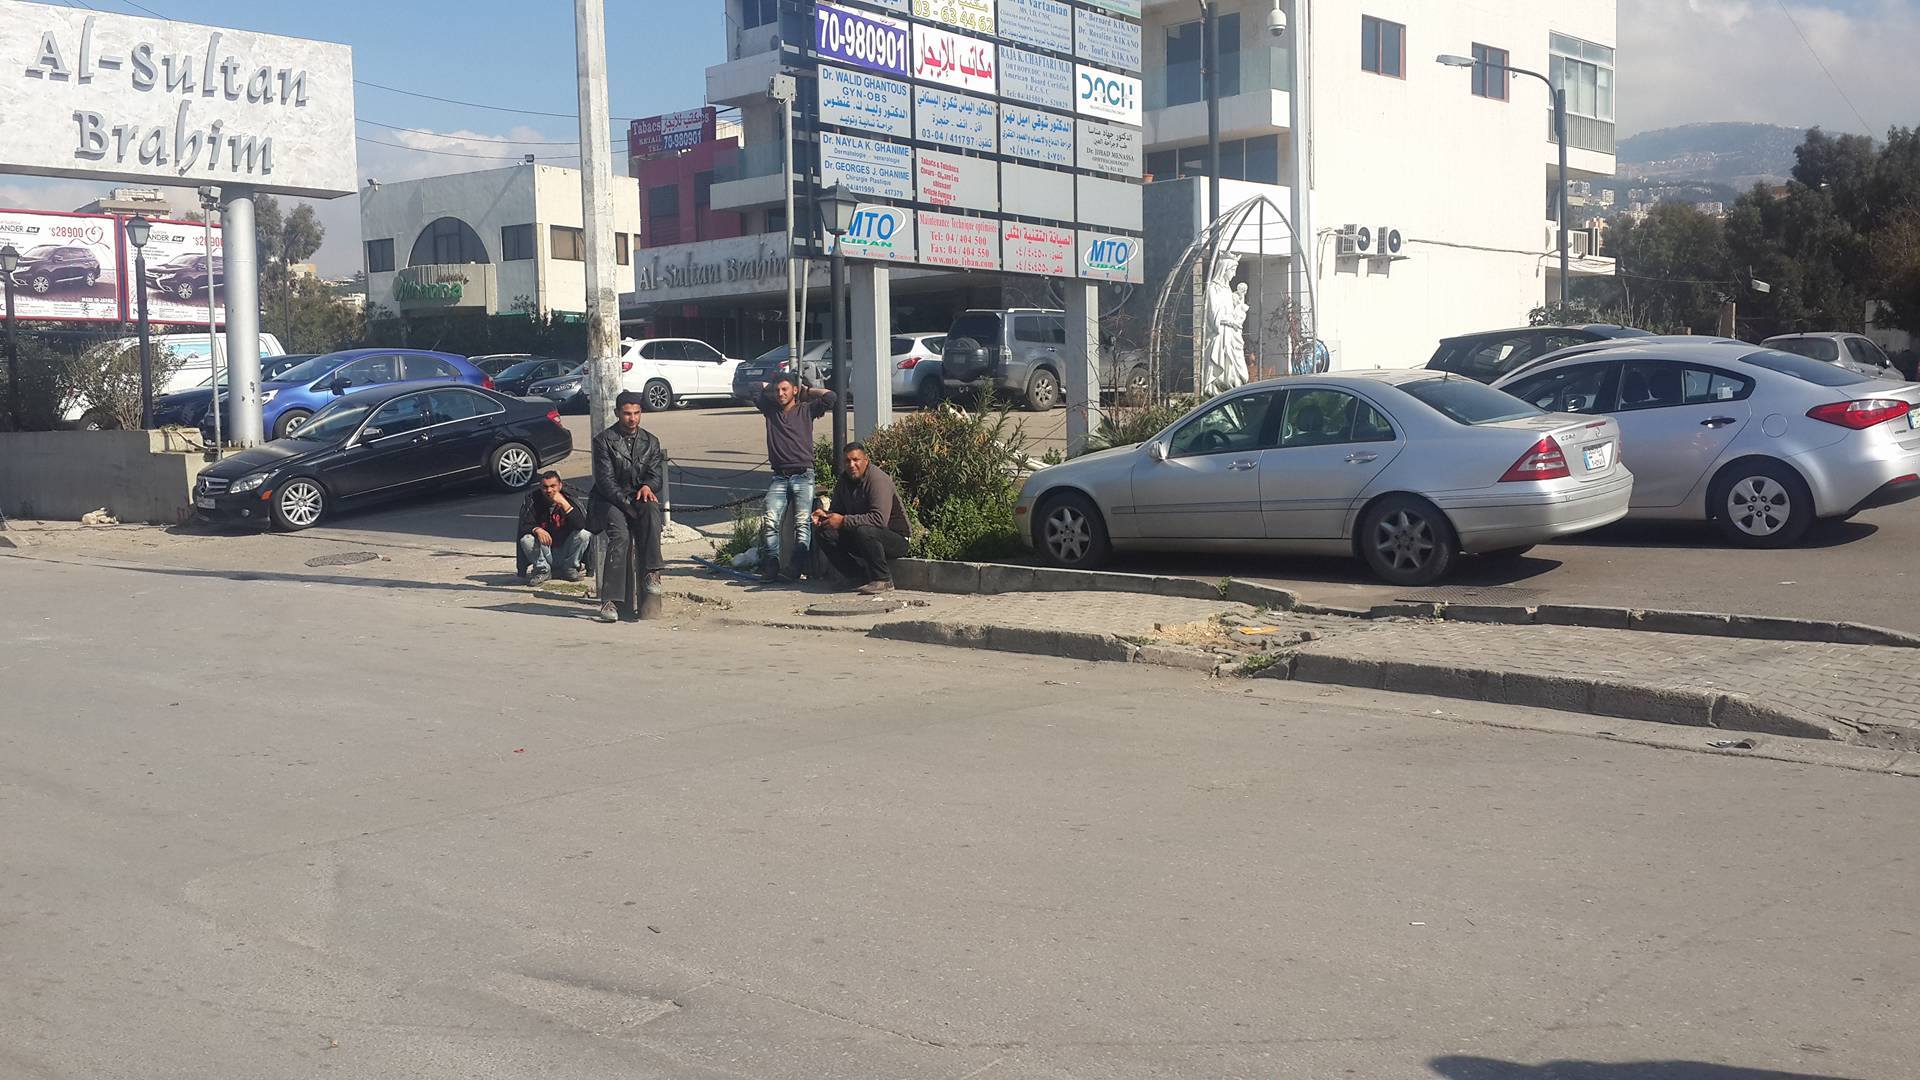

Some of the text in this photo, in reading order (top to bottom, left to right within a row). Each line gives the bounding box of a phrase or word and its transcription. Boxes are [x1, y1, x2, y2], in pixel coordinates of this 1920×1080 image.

[914, 0, 930, 17] 03
[941, 6, 957, 24] 63
[960, 11, 976, 29] 44
[978, 16, 994, 33] 62
[1079, 10, 1087, 19] Dr.
[1113, 20, 1139, 33] KIKANO
[819, 9, 905, 71] 70-980901
[1079, 25, 1087, 35] Dr.
[1113, 35, 1139, 49] KIKANO
[25, 15, 310, 107] Al-Sultan
[1079, 41, 1088, 51] Dr.
[1111, 49, 1139, 65] KIKANO
[823, 68, 907, 96] Dr. WALID GHANTOUS
[842, 86, 887, 103] GYN-OBS
[72, 99, 275, 176] Brahim
[631, 121, 661, 135] Tabacs
[949, 133, 975, 146] 411797
[664, 131, 702, 149] 70-980901
[823, 134, 834, 144] Dr.
[835, 136, 863, 149] NAYLA
[874, 143, 909, 157] GHANIME
[824, 160, 835, 169] Dr.
[835, 161, 870, 175] GEORGES
[879, 168, 910, 180] GHANIME
[194, 235, 223, 247] $290
[931, 231, 943, 241] Tel:
[945, 232, 954, 242] 04
[930, 244, 946, 254] Fax:
[1090, 239, 1127, 265] MTO
[639, 252, 721, 291] Al-Sultan
